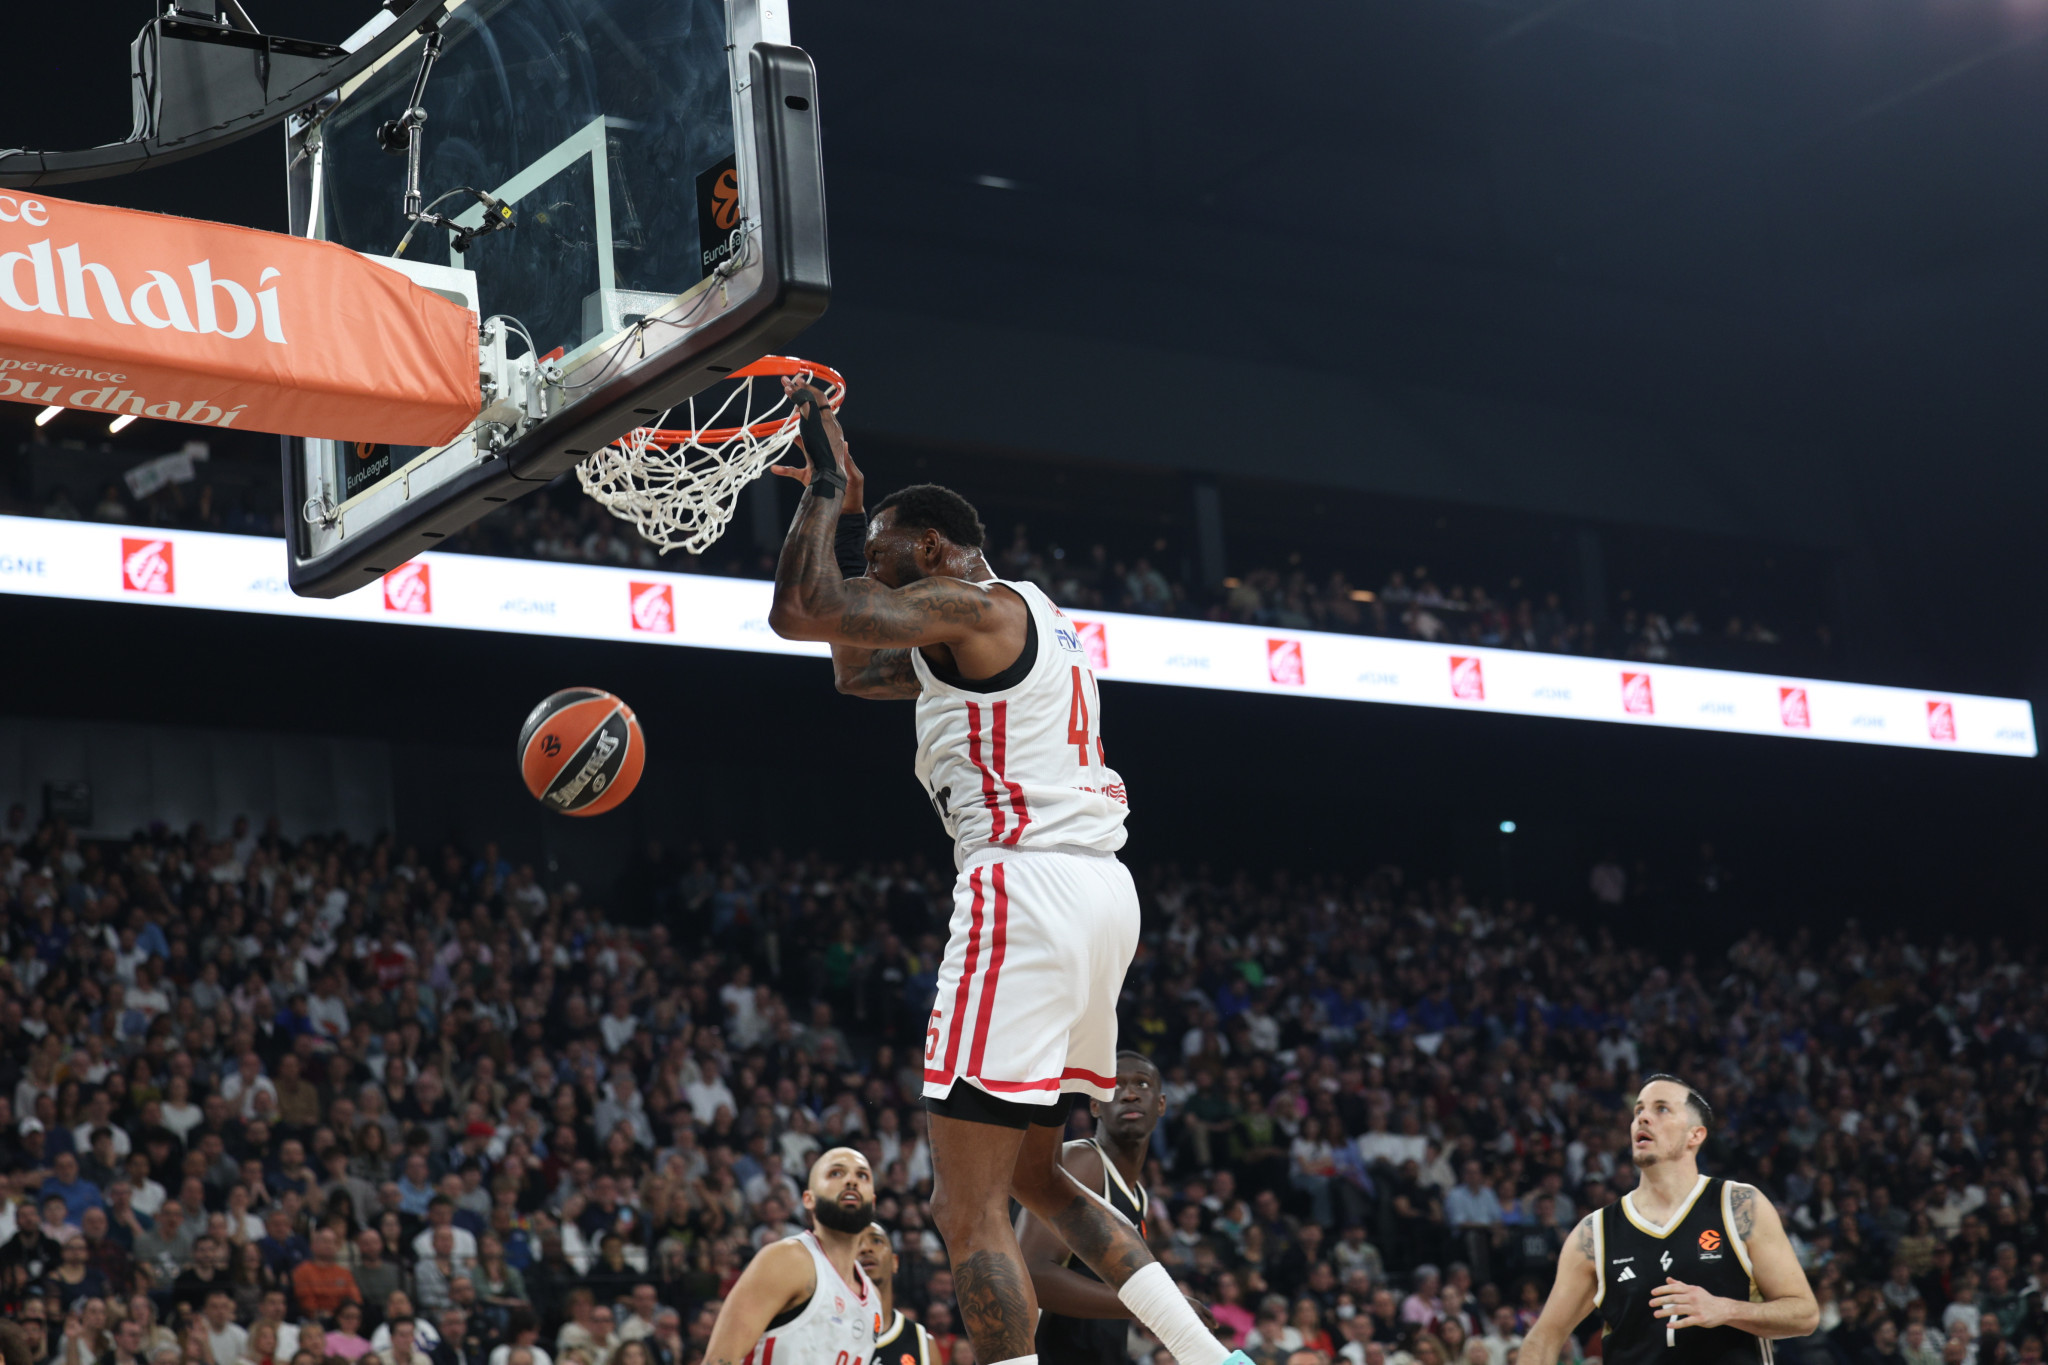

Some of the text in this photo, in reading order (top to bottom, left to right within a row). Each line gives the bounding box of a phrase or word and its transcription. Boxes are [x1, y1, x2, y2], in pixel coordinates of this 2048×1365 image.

[703, 232, 742, 266] EuroLea
[0, 358, 127, 383] perience
[347, 455, 389, 490] EuroLeague
[547, 728, 619, 808] SPALDING
[925, 1008, 942, 1061] 5
